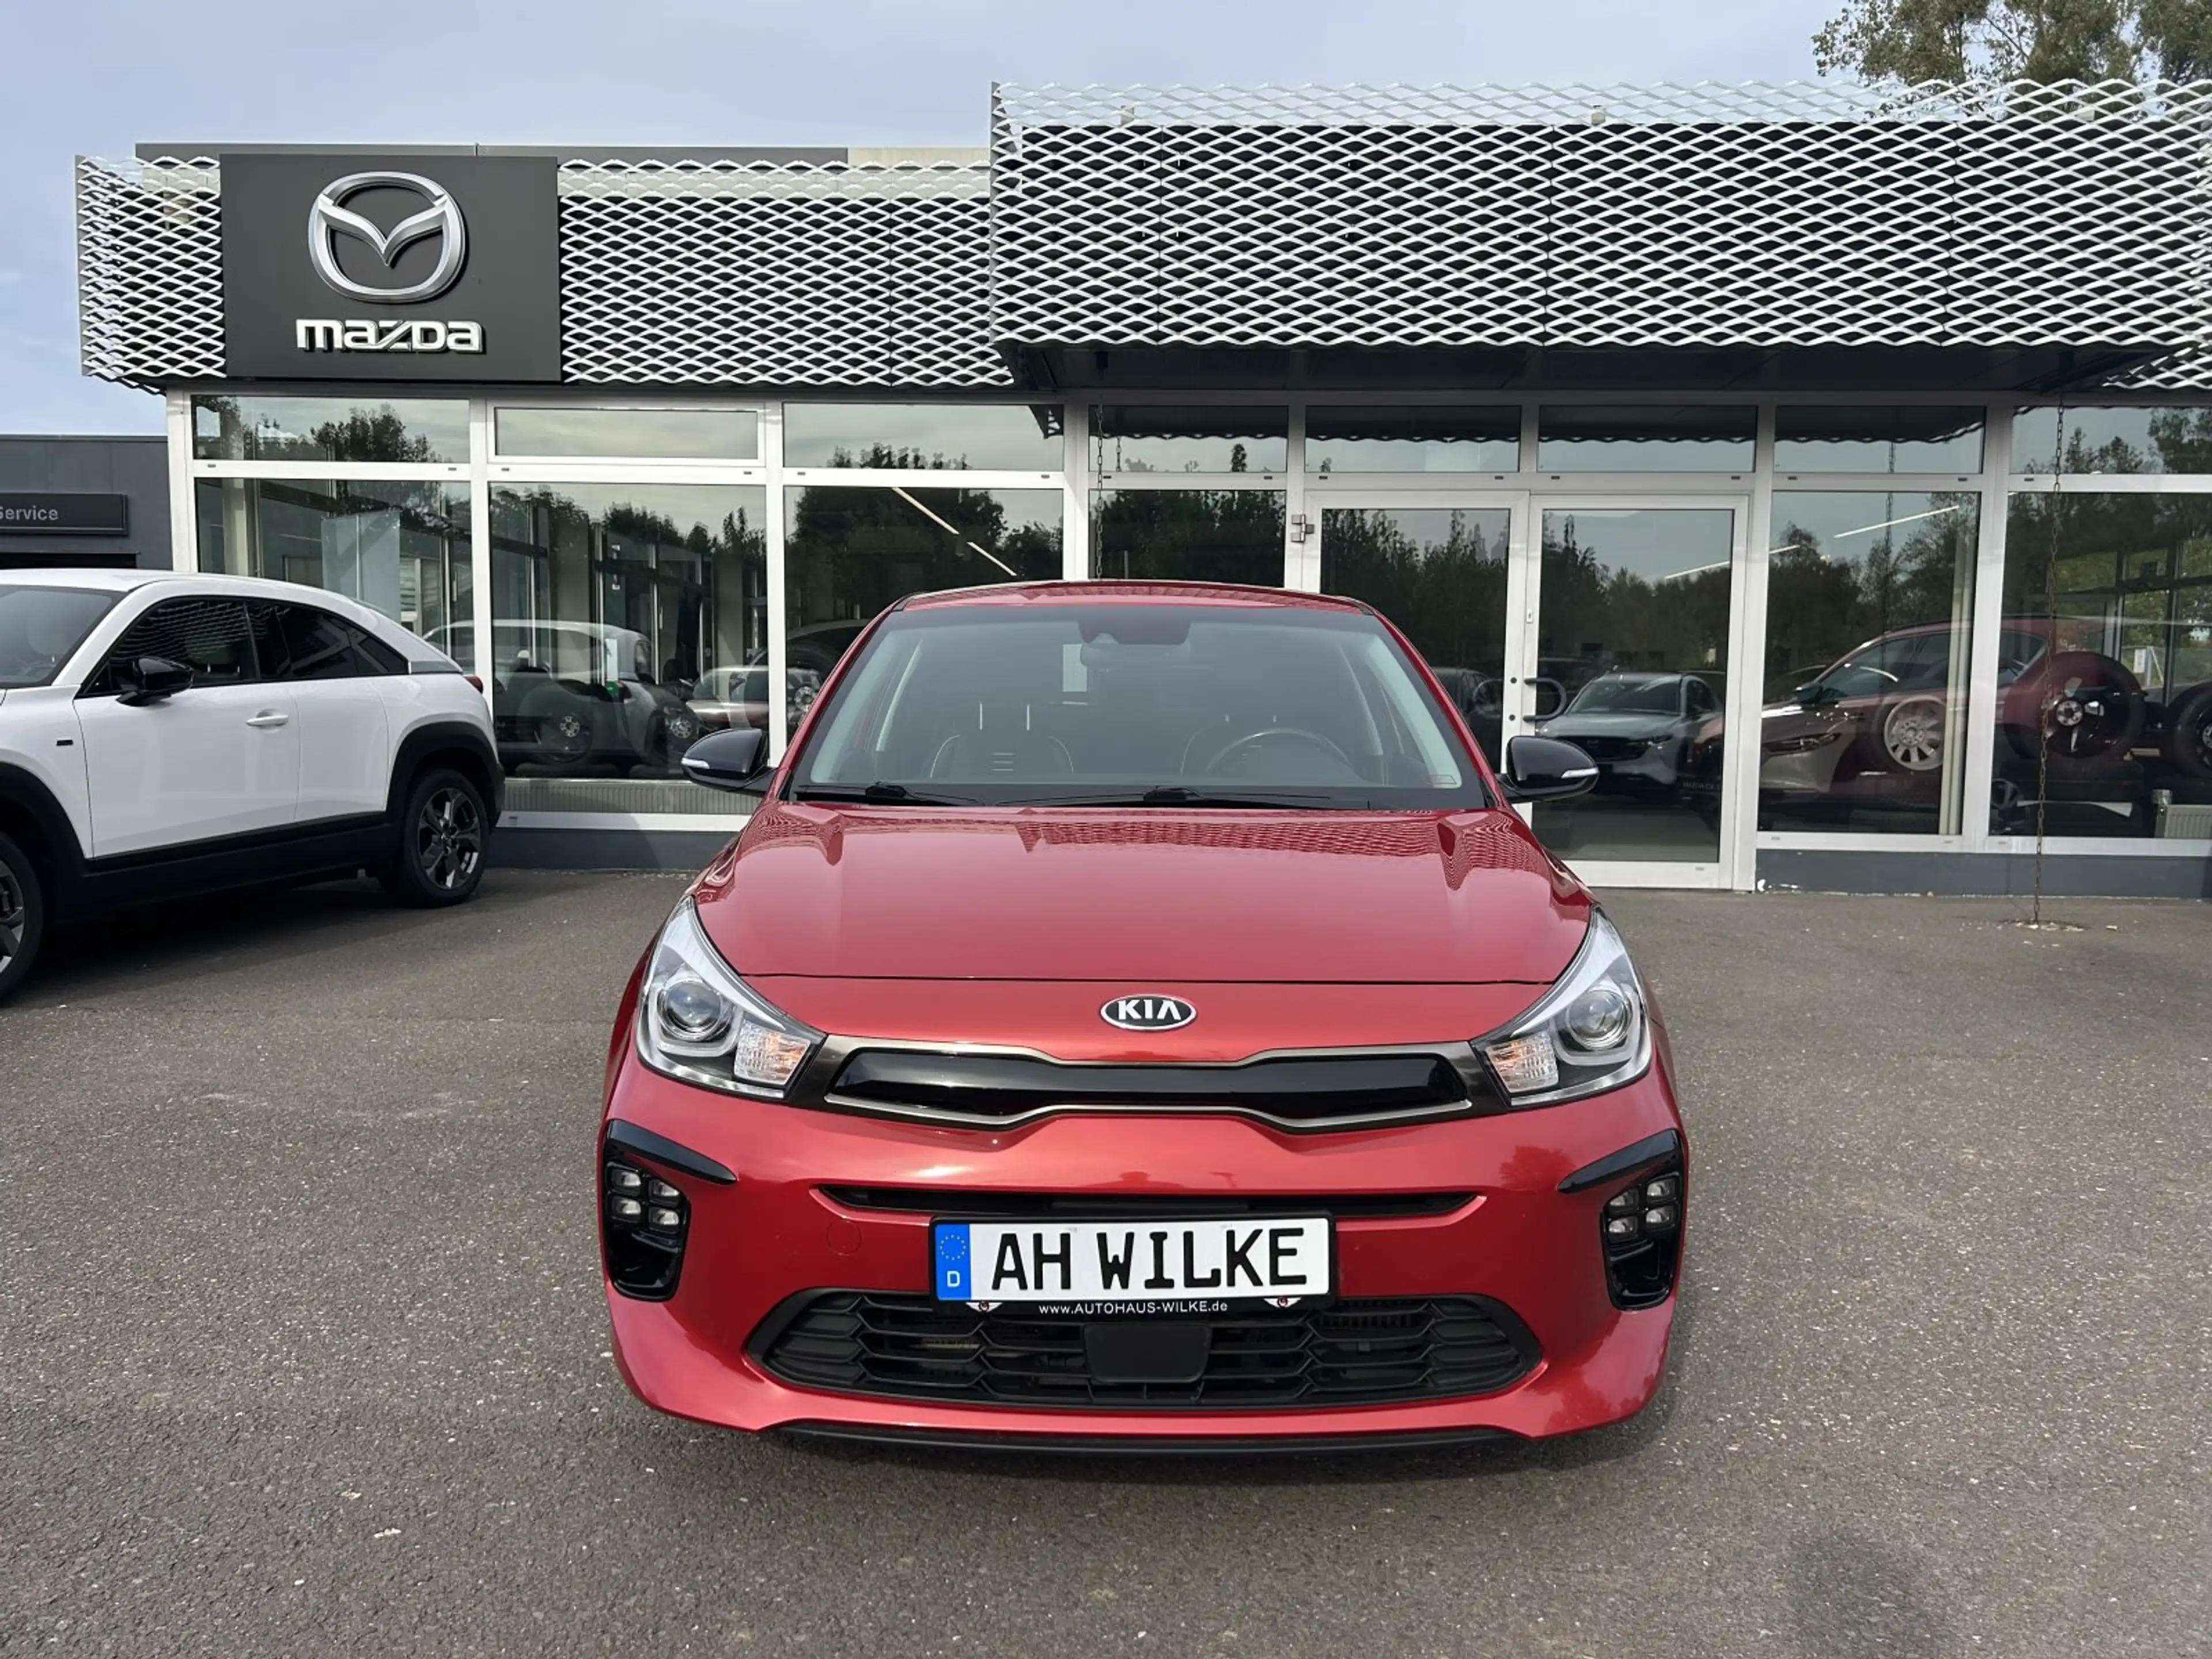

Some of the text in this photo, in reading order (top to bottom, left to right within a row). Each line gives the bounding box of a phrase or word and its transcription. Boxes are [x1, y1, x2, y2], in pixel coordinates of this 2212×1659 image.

[1118, 999, 1181, 1020] KIA
[991, 1228, 1306, 1290] AH WILKE
[947, 1271, 960, 1287] D
[1039, 1300, 1228, 1315] www.AUTOHAUS-WILKE.de
